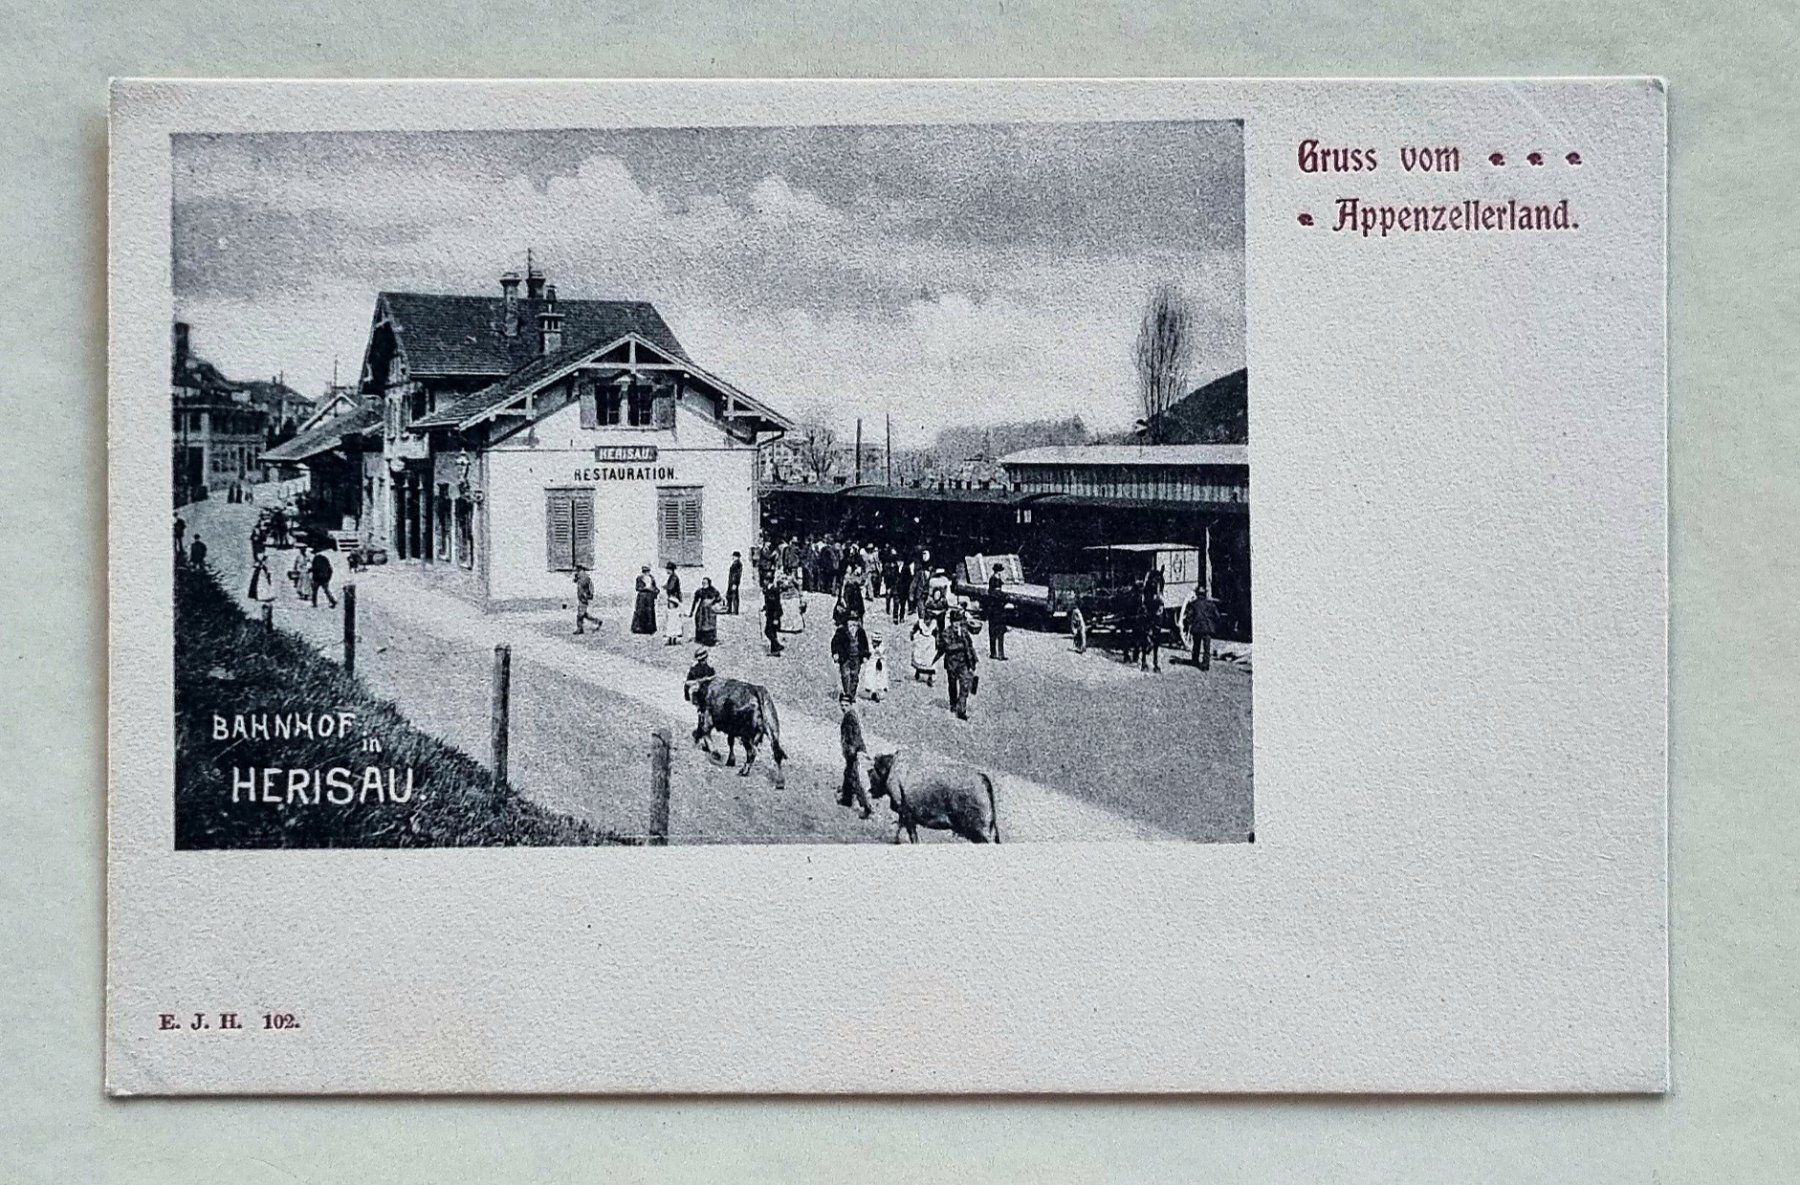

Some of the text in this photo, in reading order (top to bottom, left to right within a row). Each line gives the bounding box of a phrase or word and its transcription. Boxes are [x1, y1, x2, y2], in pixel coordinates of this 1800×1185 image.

[1298, 139, 1460, 173] Gruss vom
[1332, 198, 1580, 237] Appenzellerland.
[574, 467, 679, 481] RESTAURATION.
[212, 712, 356, 741] BAHNHOF
[362, 730, 383, 753] in
[158, 1012, 301, 1031] E. J. H. 102.
